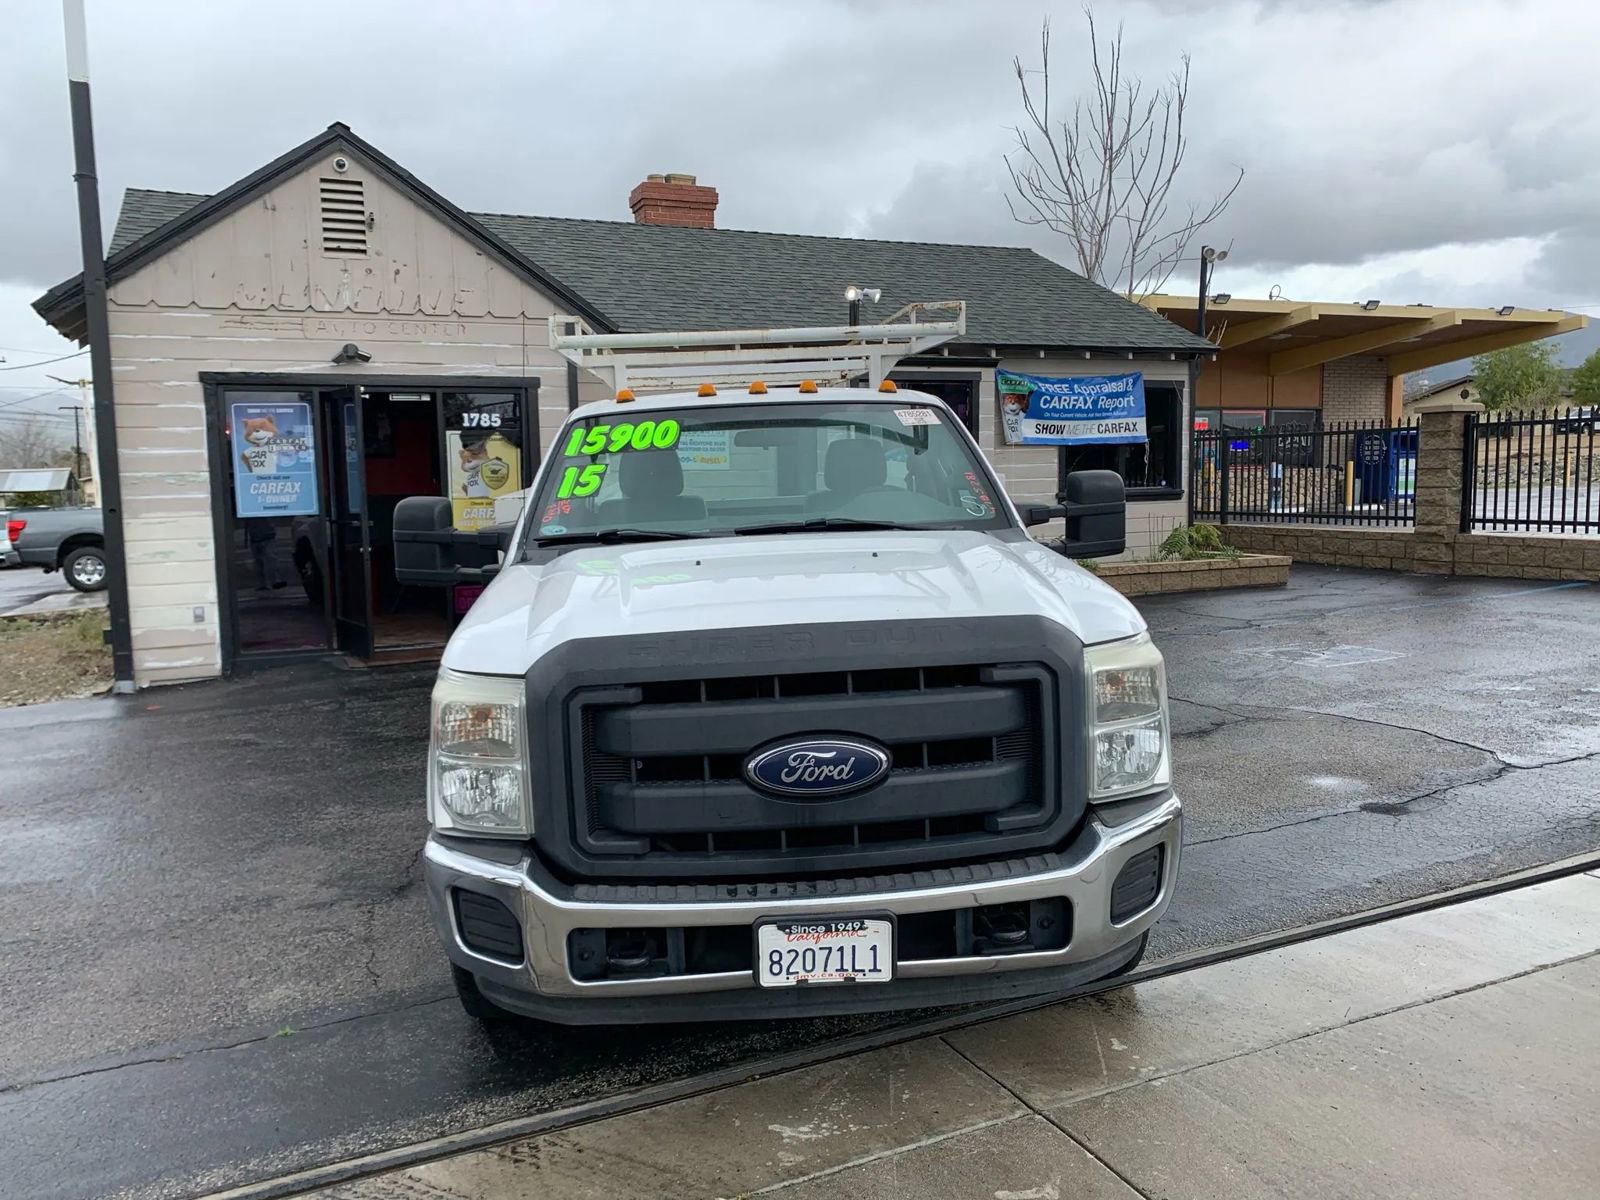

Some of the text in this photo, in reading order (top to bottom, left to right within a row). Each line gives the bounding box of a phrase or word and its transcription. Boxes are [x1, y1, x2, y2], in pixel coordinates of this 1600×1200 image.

[1038, 383, 1073, 394] FREE
[1074, 381, 1127, 396] Appraisal
[1040, 396, 1135, 411] CARFAX Report
[462, 413, 502, 428] 1785
[1035, 422, 1138, 435] SHOW ME THE CARFAX
[564, 419, 681, 457] 15900
[250, 482, 302, 494] CARFAX
[556, 464, 608, 499] 15
[628, 622, 982, 658] SUPER DUTY
[780, 751, 856, 783] Ford
[791, 922, 861, 934] Since 1949
[785, 931, 868, 944] California
[769, 945, 882, 977] 82071L1
